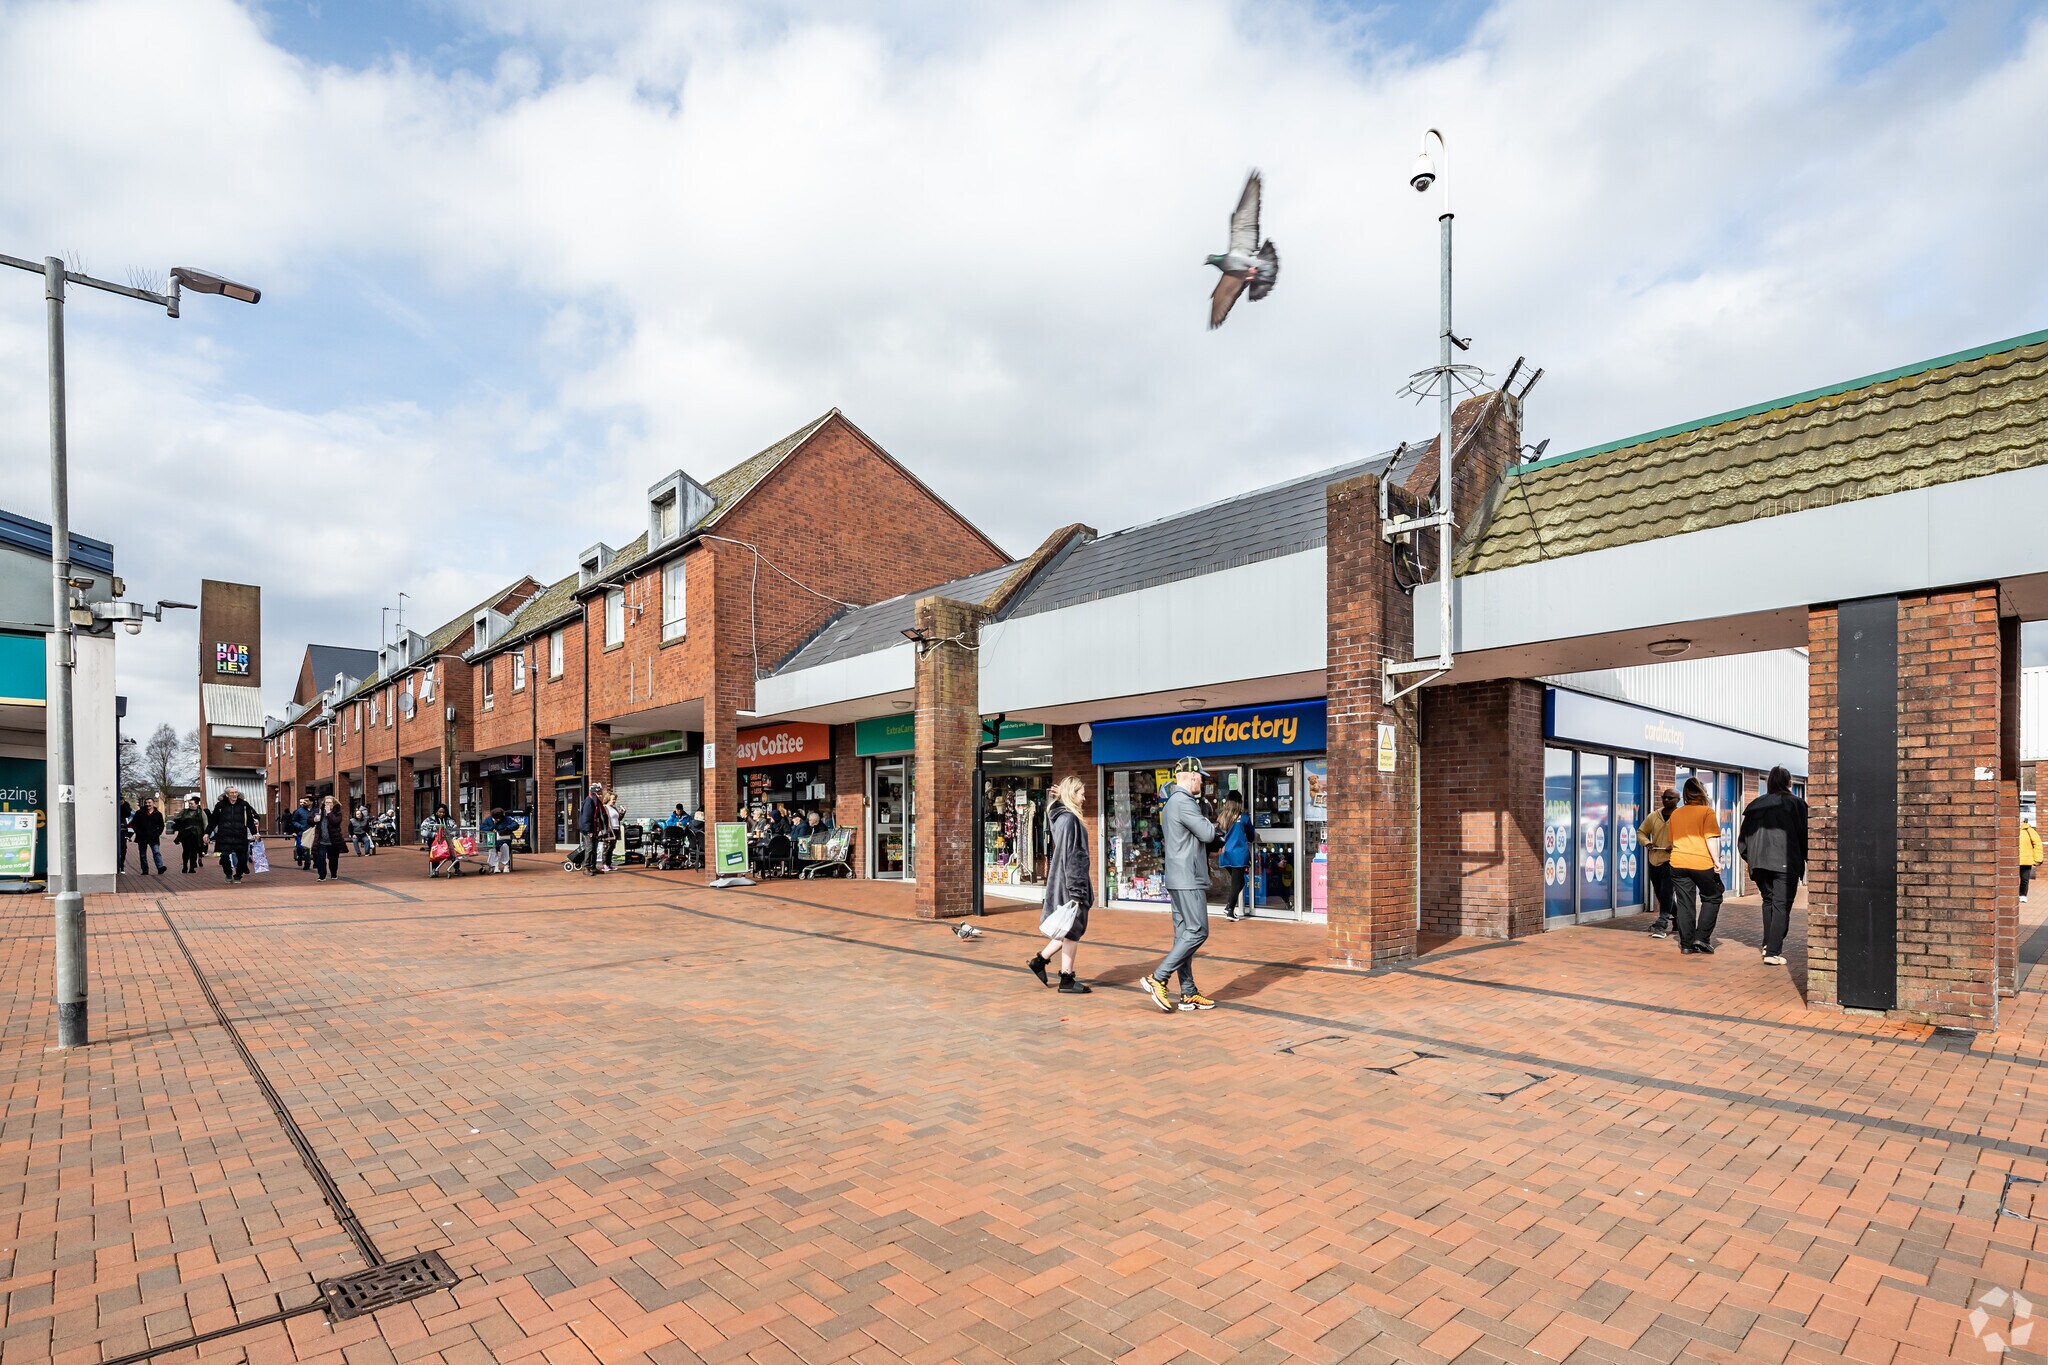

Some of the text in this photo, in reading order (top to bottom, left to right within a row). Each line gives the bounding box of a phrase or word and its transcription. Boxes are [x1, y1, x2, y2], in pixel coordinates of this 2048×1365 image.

[217, 643, 248, 654] HAR
[217, 652, 248, 664] PUR
[217, 661, 248, 672] HEY
[886, 723, 914, 735] ExtraCare
[1171, 714, 1298, 746] cardfactory
[1644, 720, 1685, 752] cardfactory
[0, 786, 37, 805] azing
